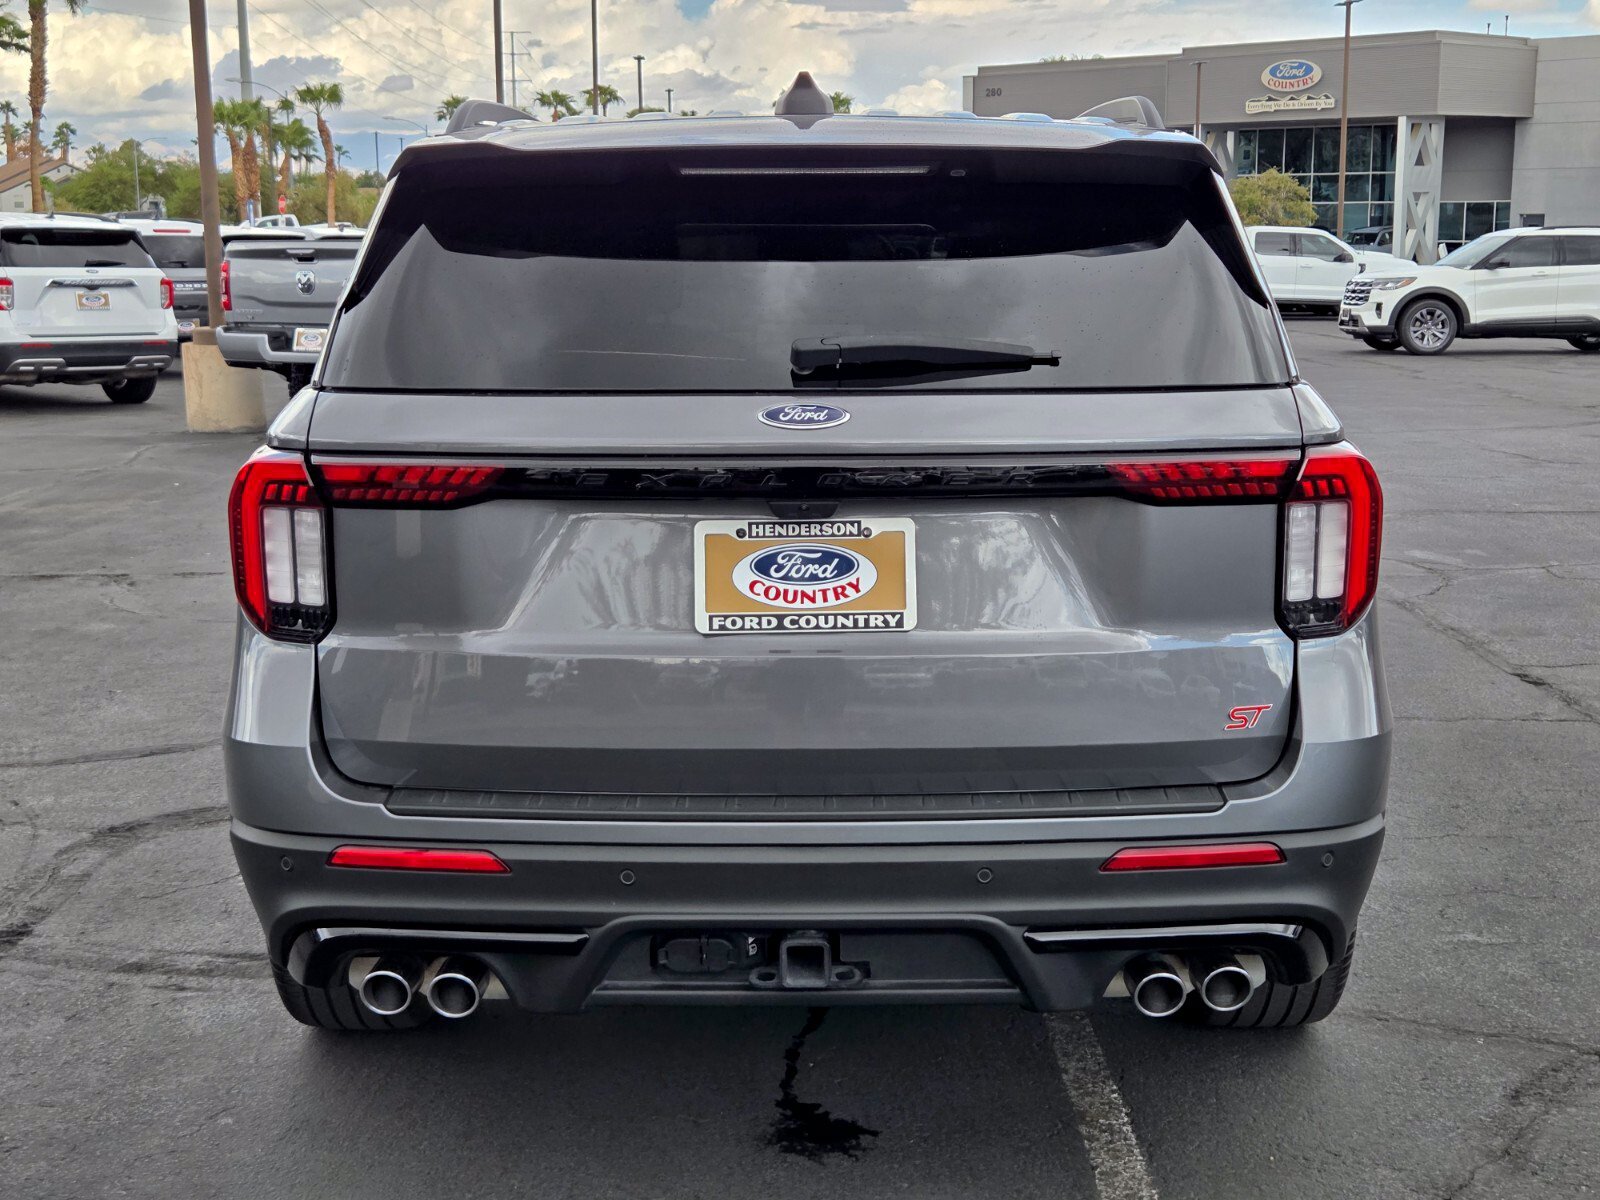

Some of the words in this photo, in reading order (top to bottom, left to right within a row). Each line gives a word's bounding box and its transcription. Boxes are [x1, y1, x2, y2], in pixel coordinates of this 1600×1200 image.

[1276, 62, 1306, 77] Ford
[1267, 75, 1315, 89] COUNTRY
[985, 87, 1002, 97] 280
[779, 405, 828, 421] Ford
[575, 471, 1036, 488] EXPLORER
[751, 523, 858, 537] HENDERSON
[770, 551, 838, 579] Ford
[749, 577, 862, 605] COUNTRY
[712, 616, 778, 630] FORD
[783, 614, 901, 630] COUNTRY
[1224, 703, 1273, 730] ST
